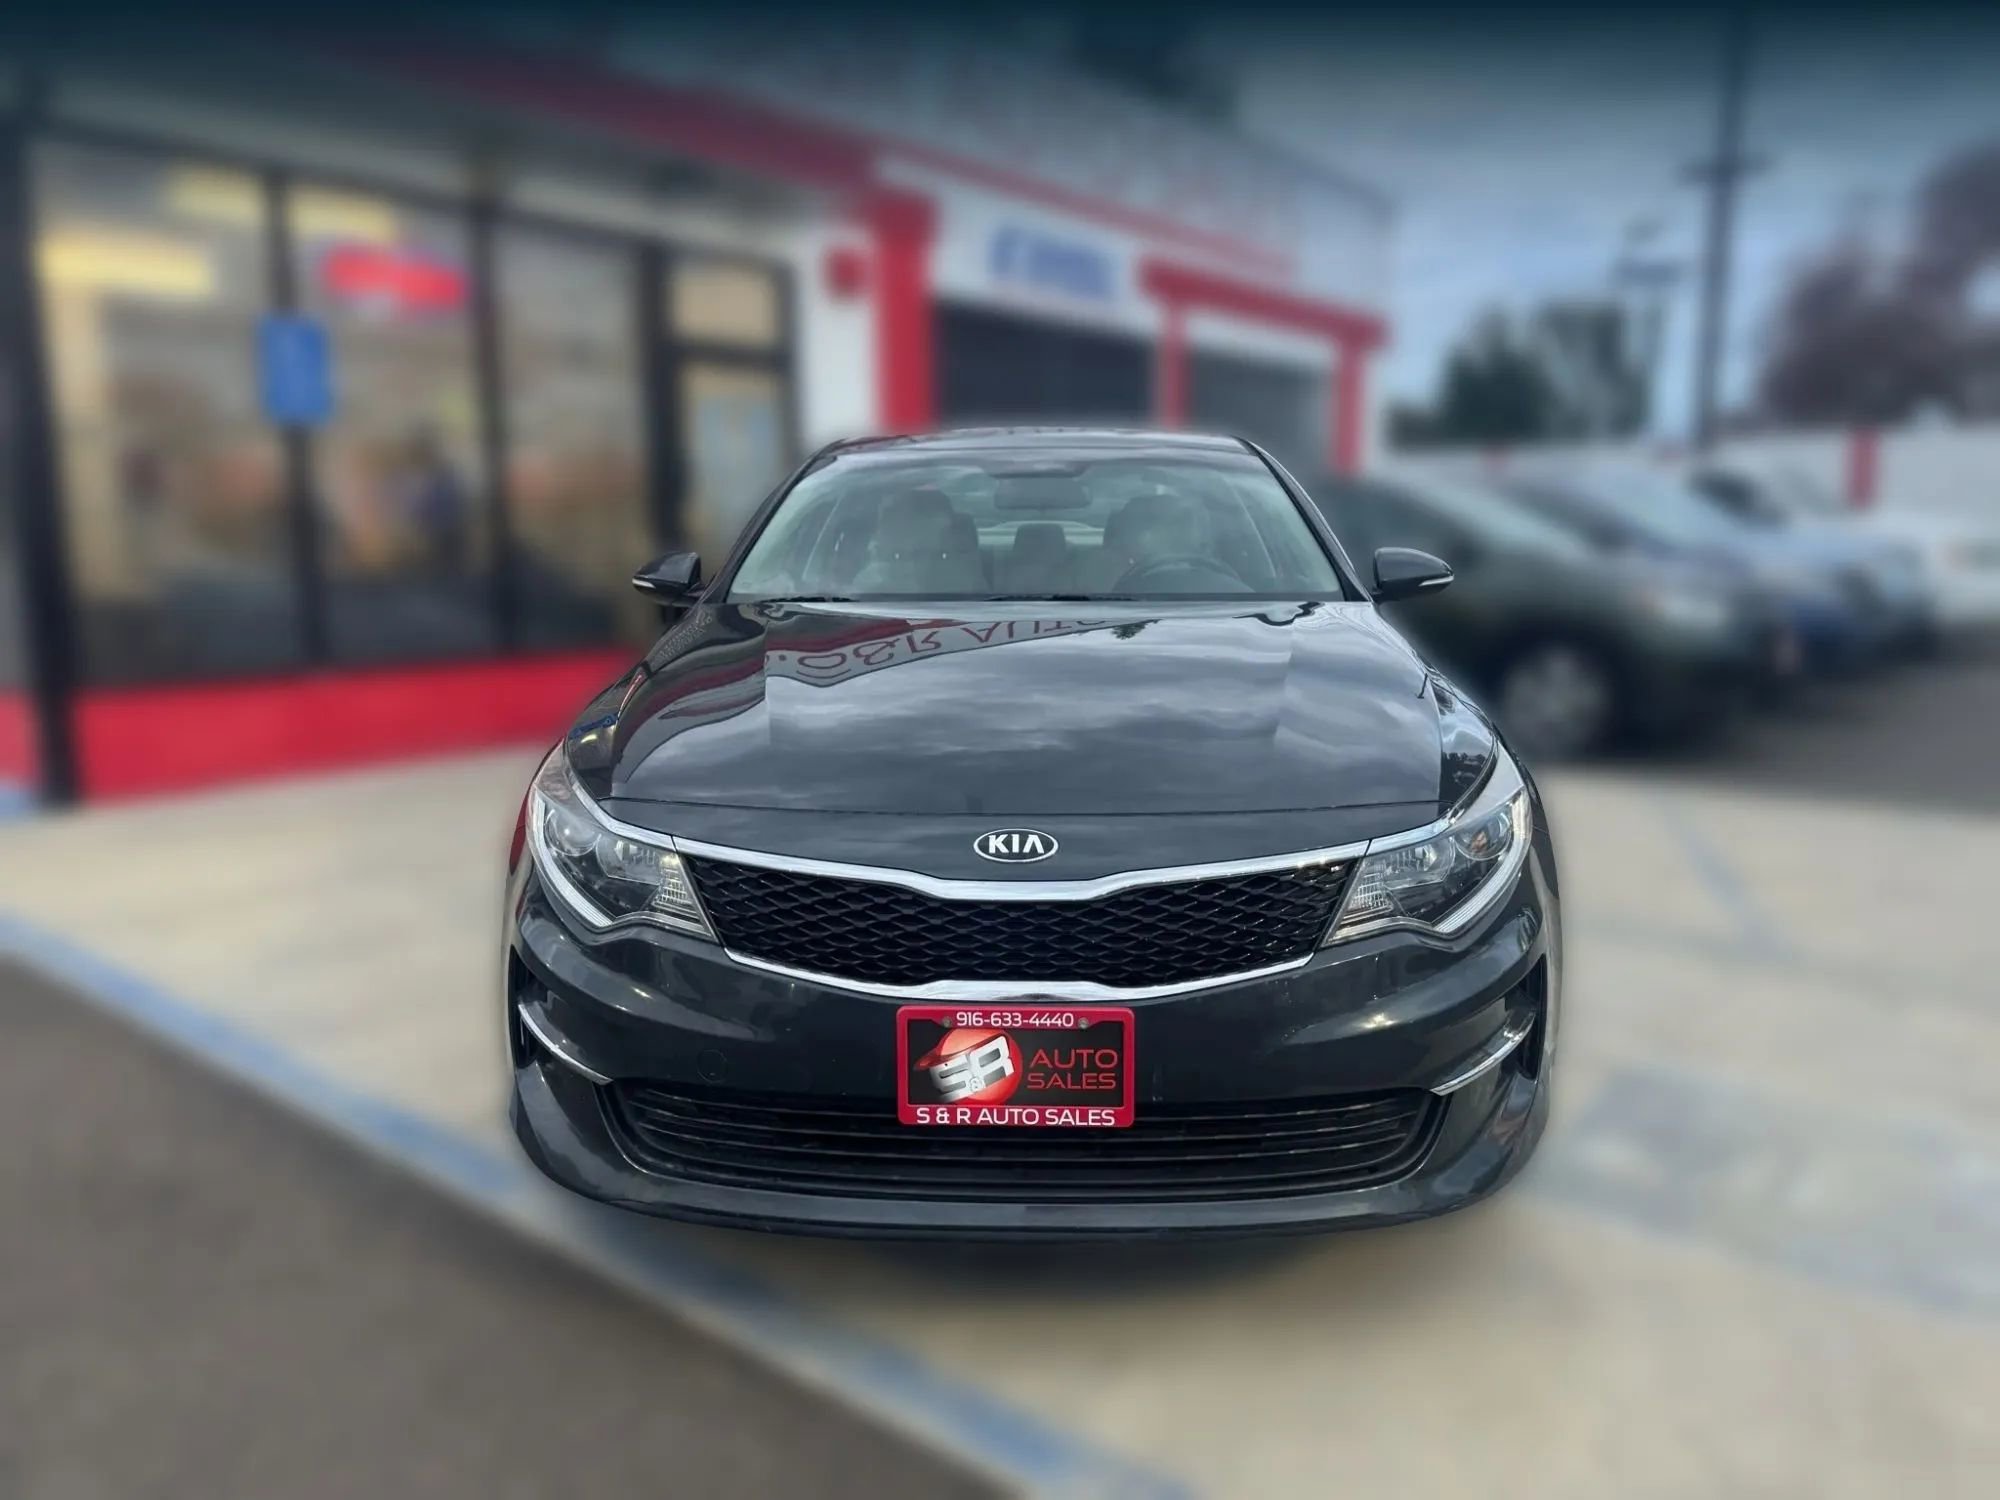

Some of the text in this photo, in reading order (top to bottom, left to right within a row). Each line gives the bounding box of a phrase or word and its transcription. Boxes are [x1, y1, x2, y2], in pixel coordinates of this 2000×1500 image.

[988, 834, 1045, 854] KIA
[955, 1012, 1074, 1028] 916-633-4440
[1029, 1049, 1118, 1069] AUTO
[1026, 1073, 1116, 1090] SALES
[916, 1107, 1116, 1126] S & R AUTO SALES
